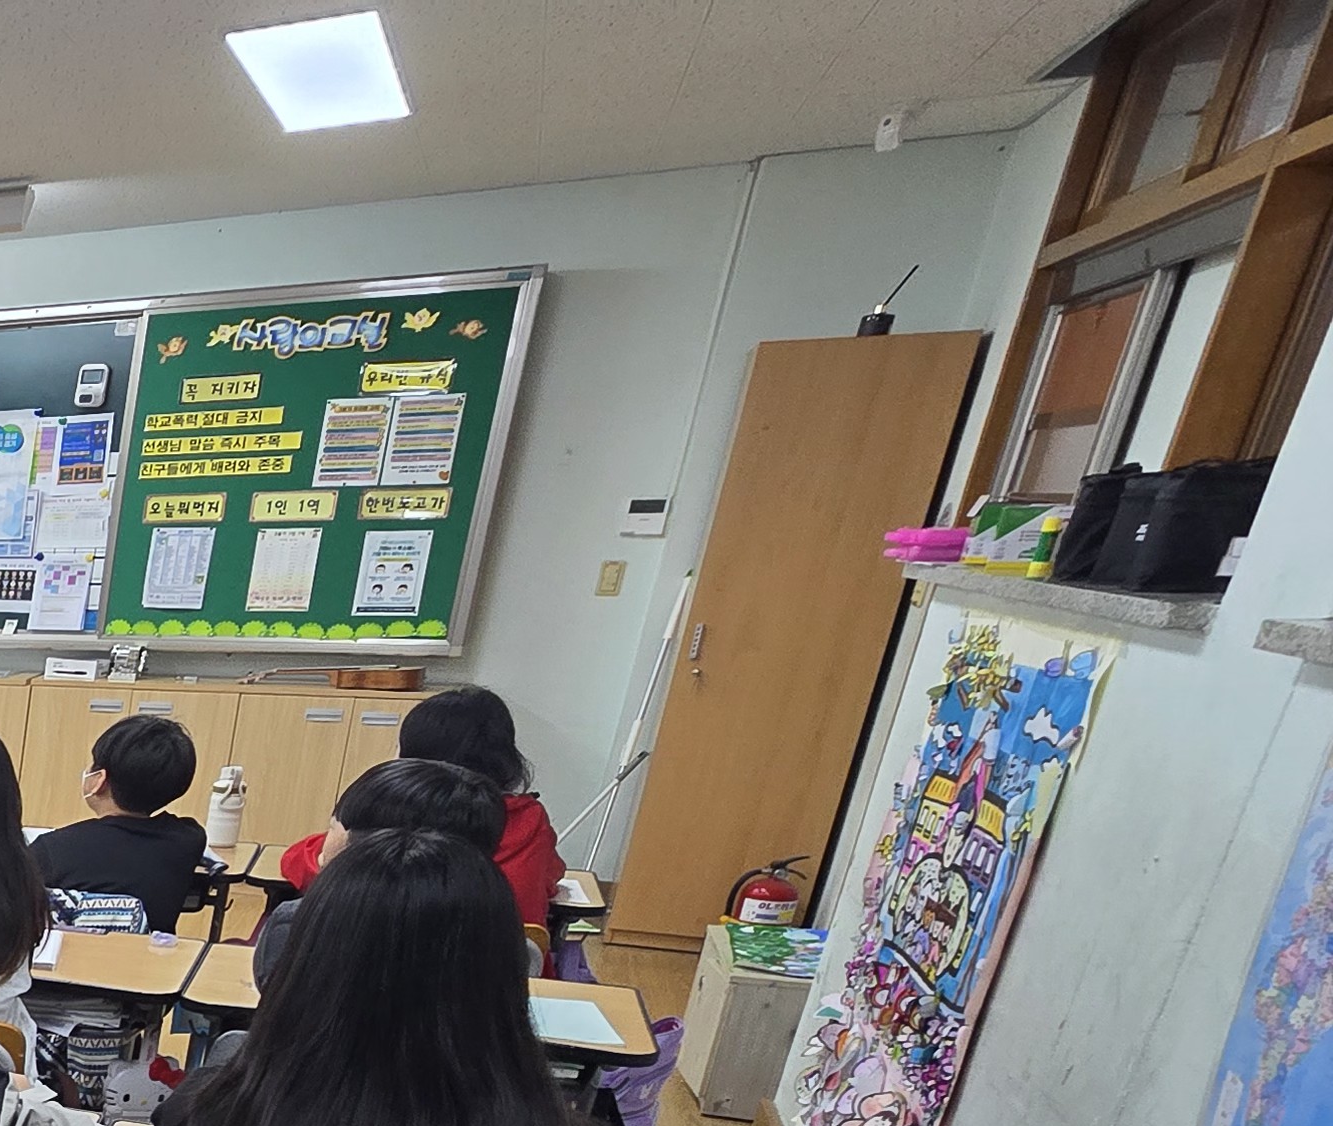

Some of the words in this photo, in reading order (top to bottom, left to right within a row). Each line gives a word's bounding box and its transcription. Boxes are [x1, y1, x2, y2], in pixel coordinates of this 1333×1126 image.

[185, 383, 199, 400] 꼭
[211, 380, 257, 396] 지키자
[147, 413, 199, 428] 학교폭력
[201, 411, 229, 426] 절대
[235, 409, 263, 424] 금지
[144, 439, 182, 454] 선생님
[189, 437, 215, 451] 말씀
[220, 436, 247, 450] 즉시
[253, 434, 281, 448] 주목
[141, 461, 206, 476] 친구들에게
[210, 459, 251, 473] 배려와
[257, 458, 285, 471] 존중
[148, 500, 220, 518] 오늘뭐먹지
[266, 499, 288, 515] 1인
[298, 498, 321, 515] 1역
